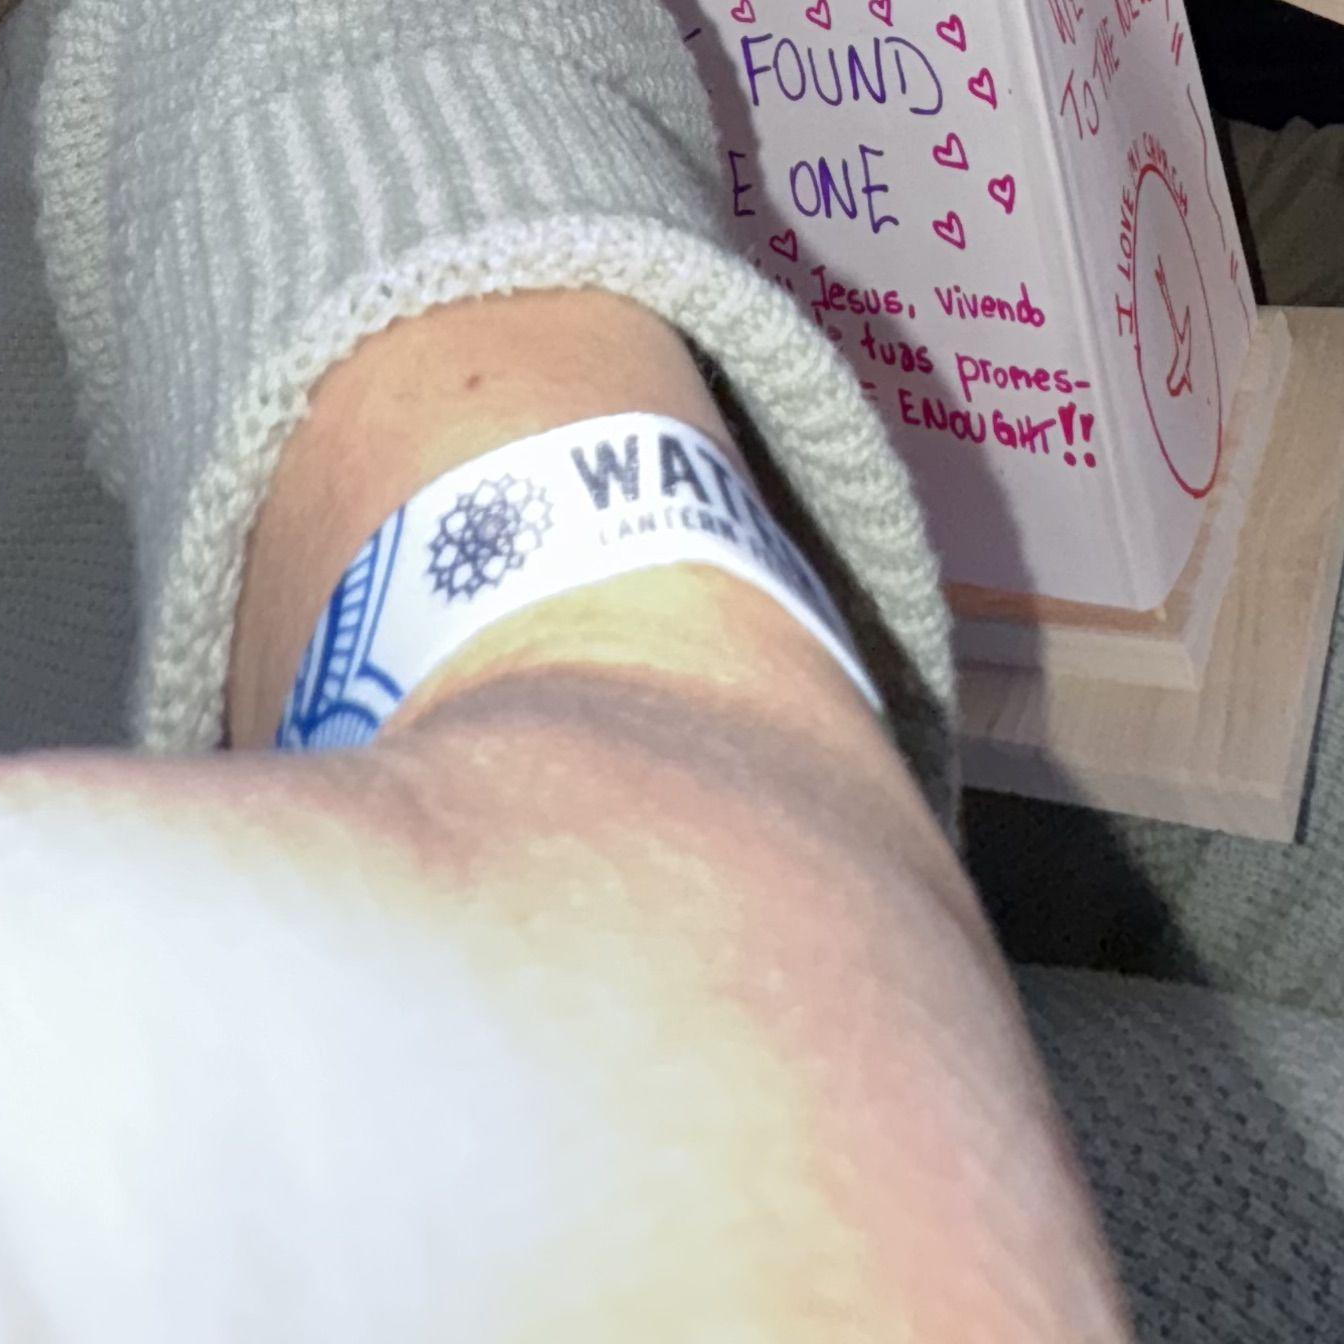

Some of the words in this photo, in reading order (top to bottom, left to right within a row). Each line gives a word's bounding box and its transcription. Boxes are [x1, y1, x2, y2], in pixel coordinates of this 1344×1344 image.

[740, 32, 944, 116] FOUND
[728, 149, 757, 218] E
[789, 143, 901, 235] ONE
[1116, 184, 1135, 281] LOVE
[860, 320, 935, 375] tuas
